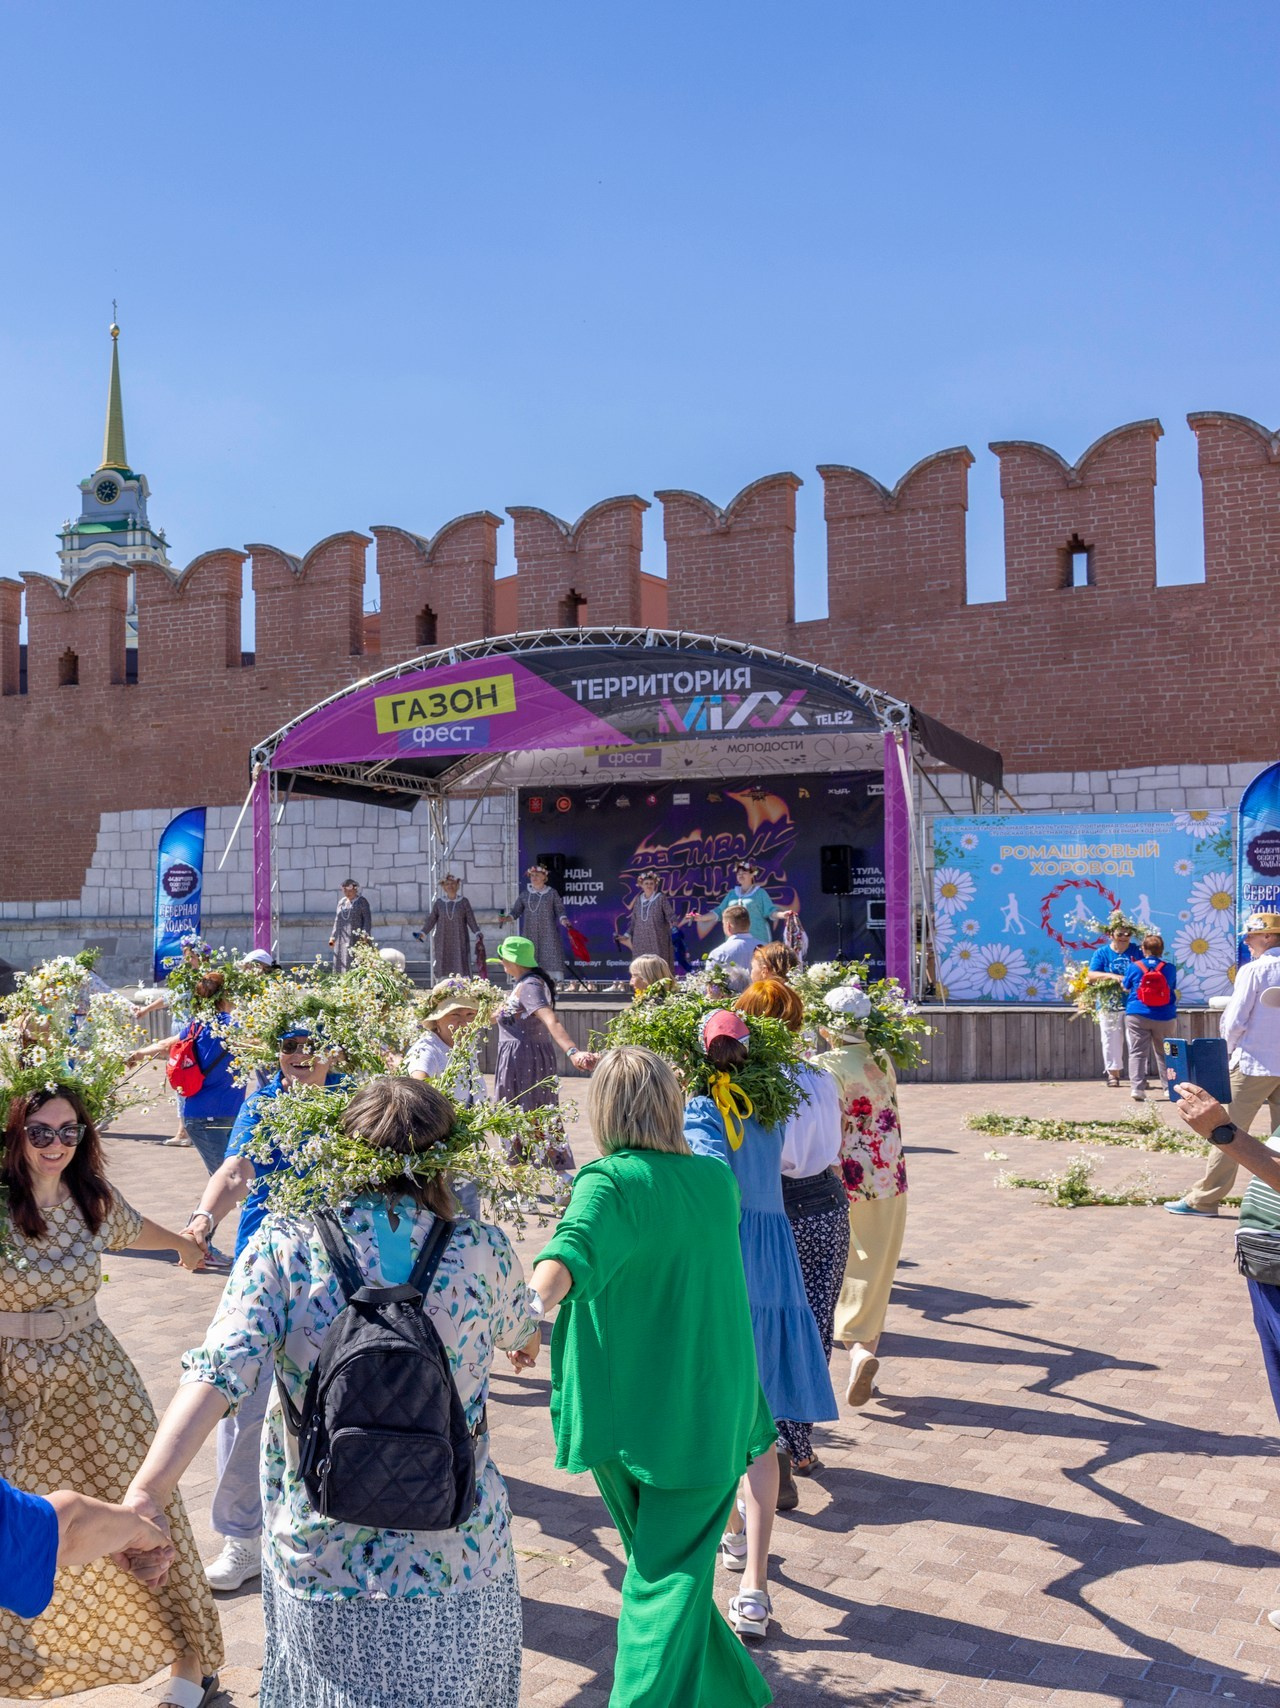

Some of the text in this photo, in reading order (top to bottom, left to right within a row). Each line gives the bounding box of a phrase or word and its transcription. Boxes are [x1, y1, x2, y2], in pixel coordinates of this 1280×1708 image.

[571, 666, 752, 701] ТЕРРИТОРИЯ
[391, 683, 499, 725] ГАЗОН
[815, 710, 854, 726] TELE2
[412, 724, 475, 748] фест
[726, 740, 804, 754] МОЛОДОСТИ
[608, 752, 652, 767] фест
[1000, 840, 1160, 860] РОМАШКОВЫЙ
[564, 868, 592, 880] НДЫ
[1030, 860, 1135, 877] ХОРОВОД
